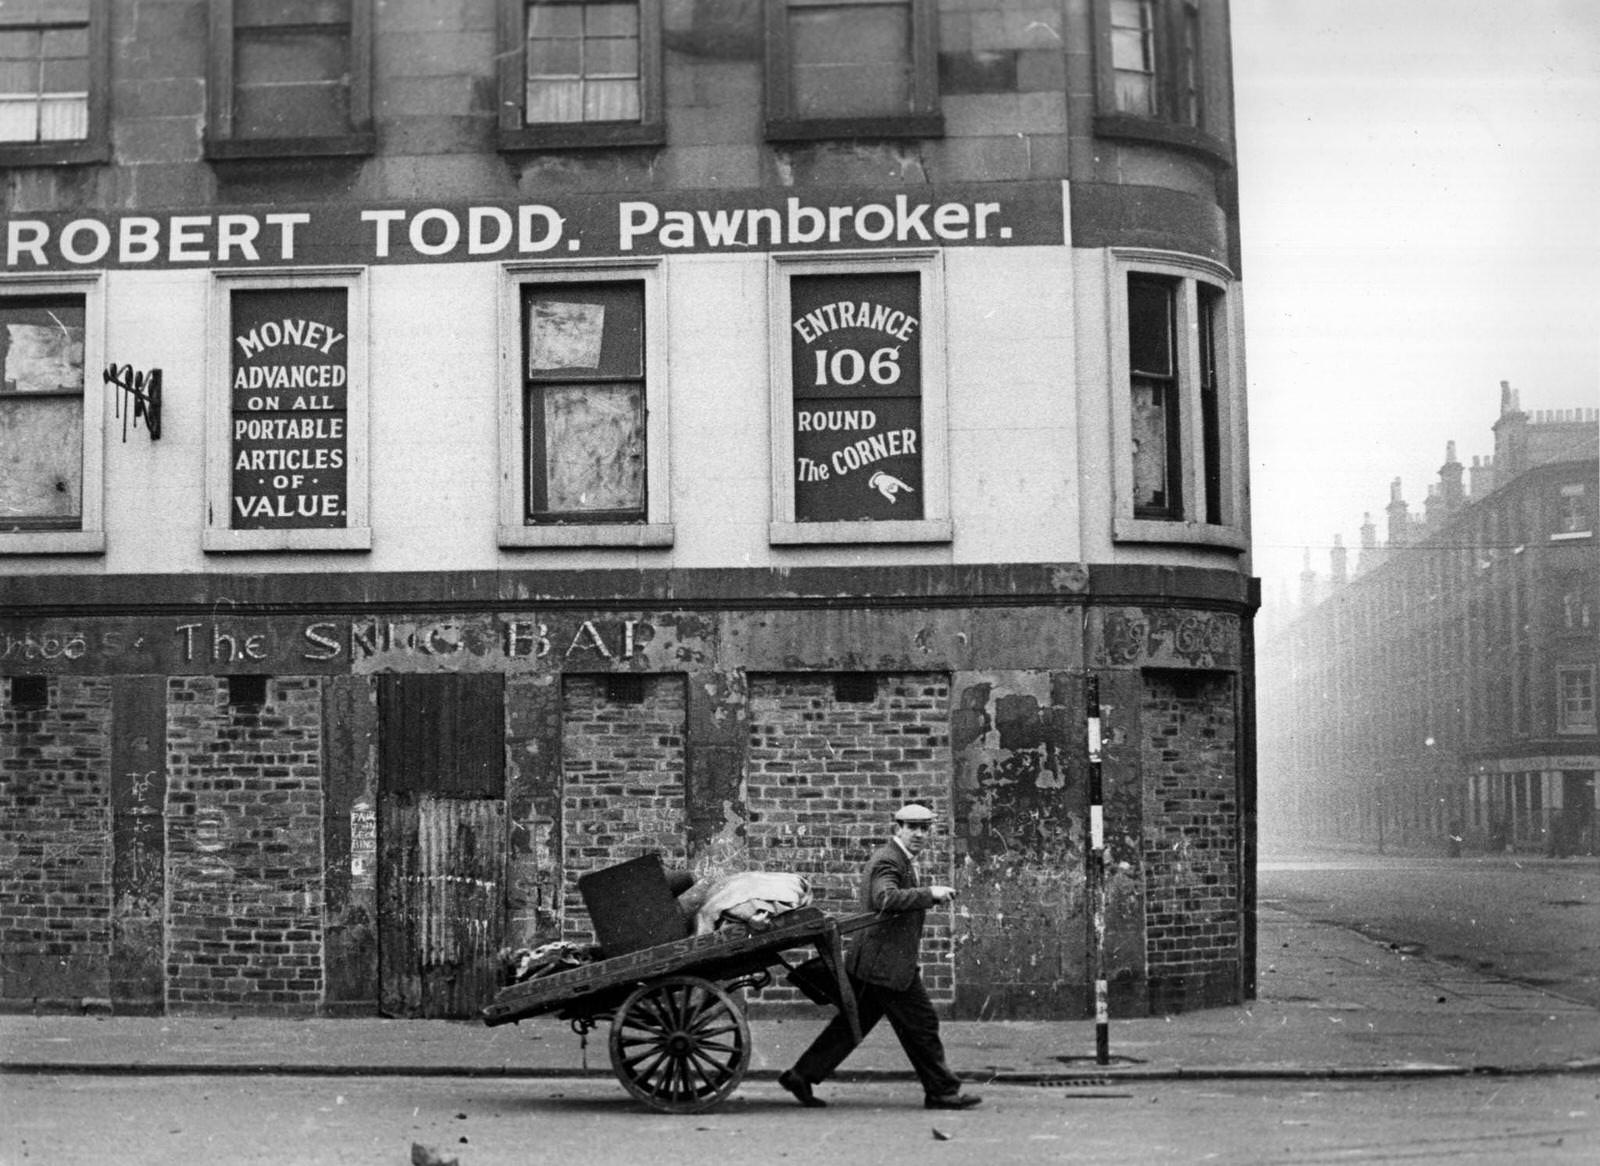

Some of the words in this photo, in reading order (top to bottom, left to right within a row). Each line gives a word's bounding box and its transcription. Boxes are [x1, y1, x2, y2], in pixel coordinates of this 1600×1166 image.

[7, 213, 311, 266] ROBERT
[360, 204, 580, 258] TODD.
[619, 194, 1013, 251] Pawnbroker.
[793, 300, 919, 344] ENTRANCE
[236, 318, 345, 359] MONEY
[234, 364, 346, 389] ADVANCED
[815, 346, 901, 386] 106
[247, 395, 280, 411] ON
[291, 395, 335, 411] ALL
[235, 418, 343, 440] PORTABLE
[798, 410, 877, 432] ROUND
[235, 448, 343, 471] ARTICLES
[797, 457, 829, 483] The
[831, 428, 918, 477] CORNER
[235, 494, 348, 518] VALUE.
[176, 622, 268, 662] The
